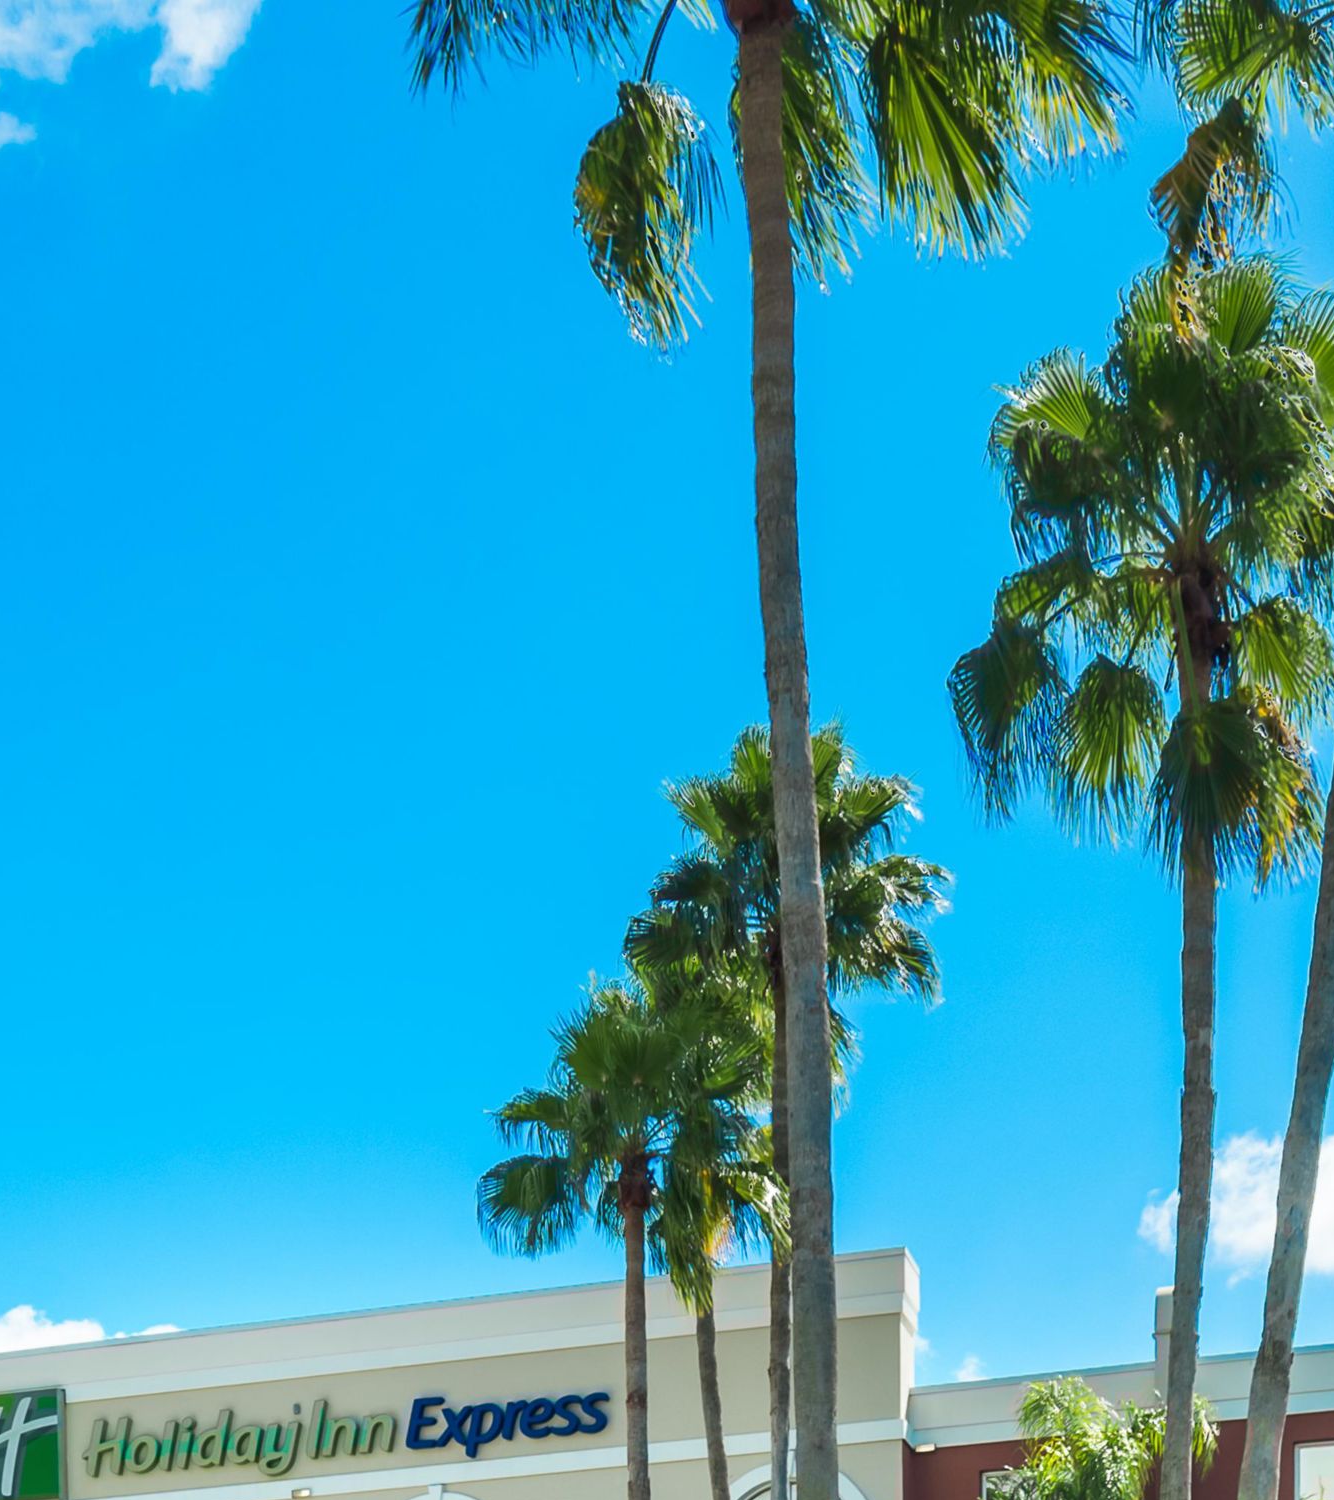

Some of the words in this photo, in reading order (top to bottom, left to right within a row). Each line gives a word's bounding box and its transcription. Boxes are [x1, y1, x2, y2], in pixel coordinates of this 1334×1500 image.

[82, 1403, 302, 1477] Holiday
[307, 1398, 397, 1460] Inn
[405, 1391, 611, 1459] Express
